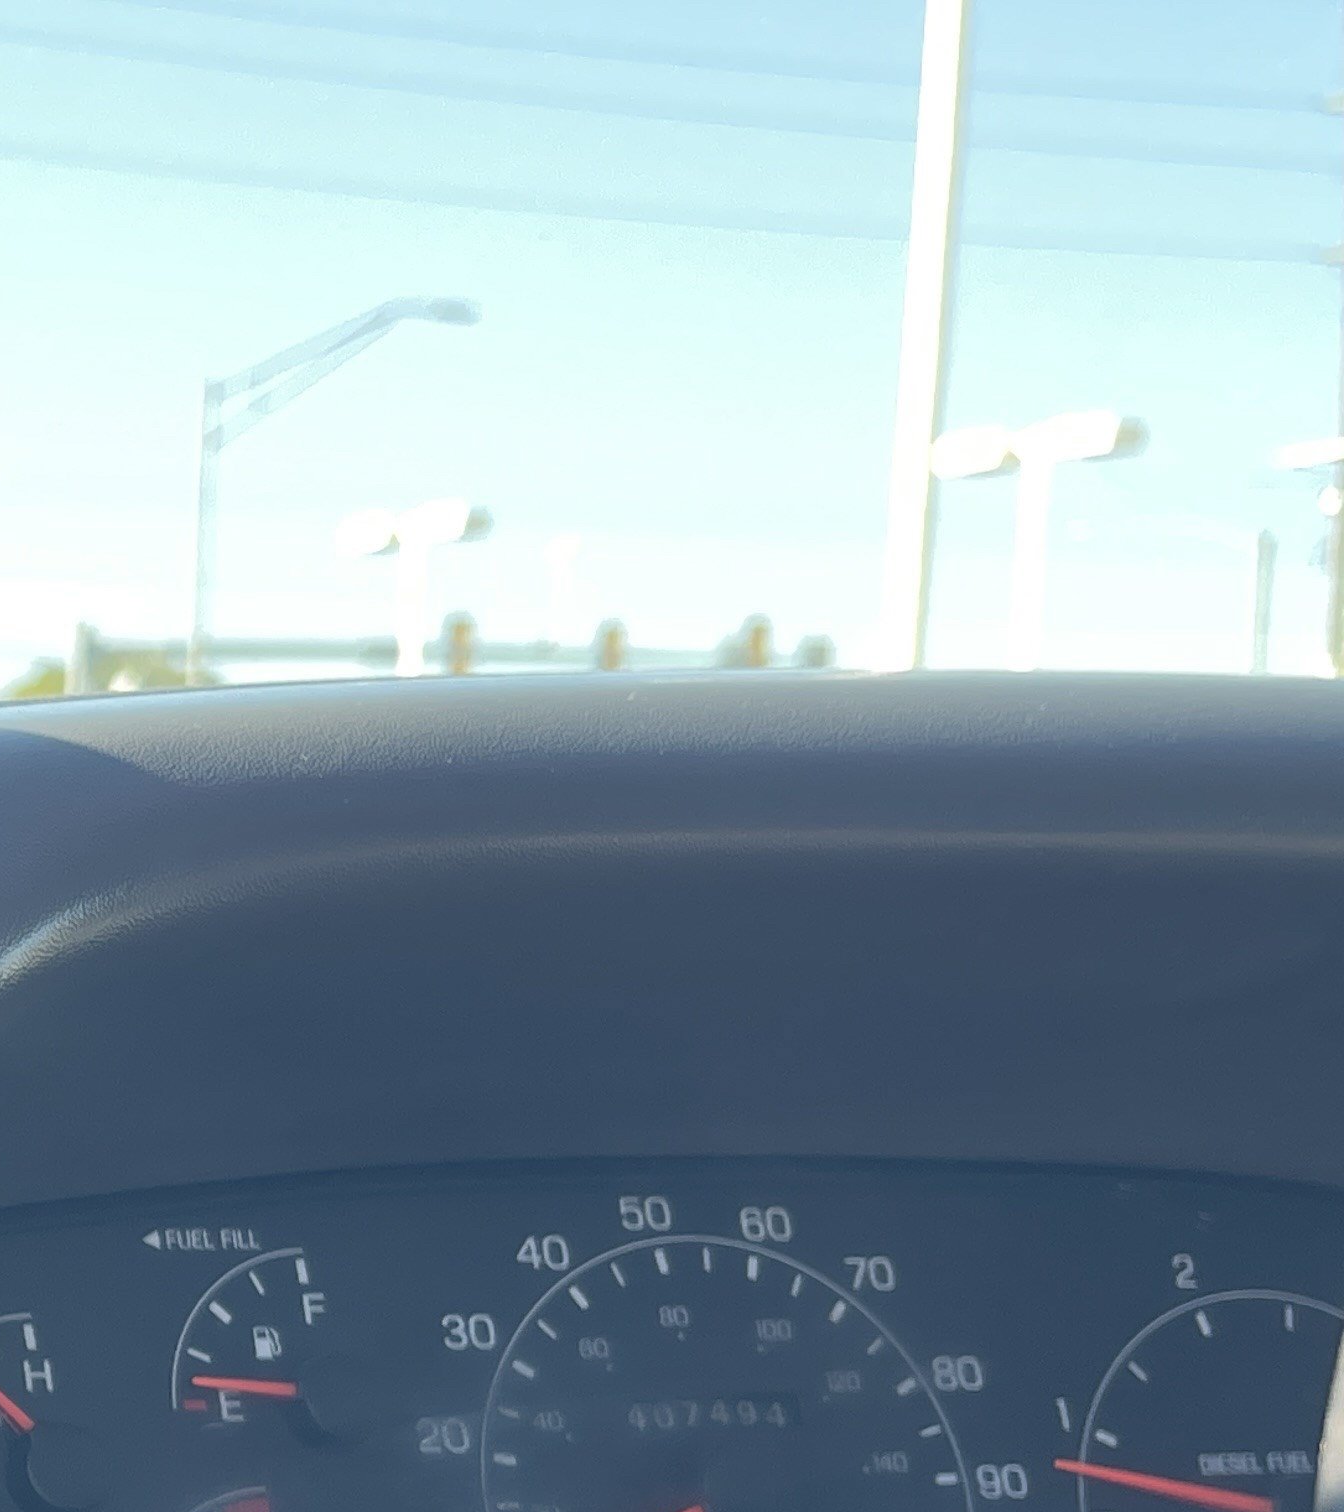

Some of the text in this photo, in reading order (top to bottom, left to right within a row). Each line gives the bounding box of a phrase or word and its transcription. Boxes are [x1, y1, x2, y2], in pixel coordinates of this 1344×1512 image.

[618, 1196, 672, 1231] 50
[738, 1206, 792, 1242] 60
[164, 1228, 260, 1250] FUEL FILL
[516, 1234, 570, 1270] 40
[843, 1256, 896, 1291] 70
[1171, 1252, 1199, 1289] 2
[301, 1292, 325, 1324] F
[441, 1314, 496, 1350] 30
[22, 1359, 54, 1393] H
[931, 1355, 984, 1391] 80
[219, 1391, 245, 1422] E
[1055, 1396, 1071, 1432] 1
[415, 1417, 470, 1453] 20
[975, 1464, 1028, 1499] 90
